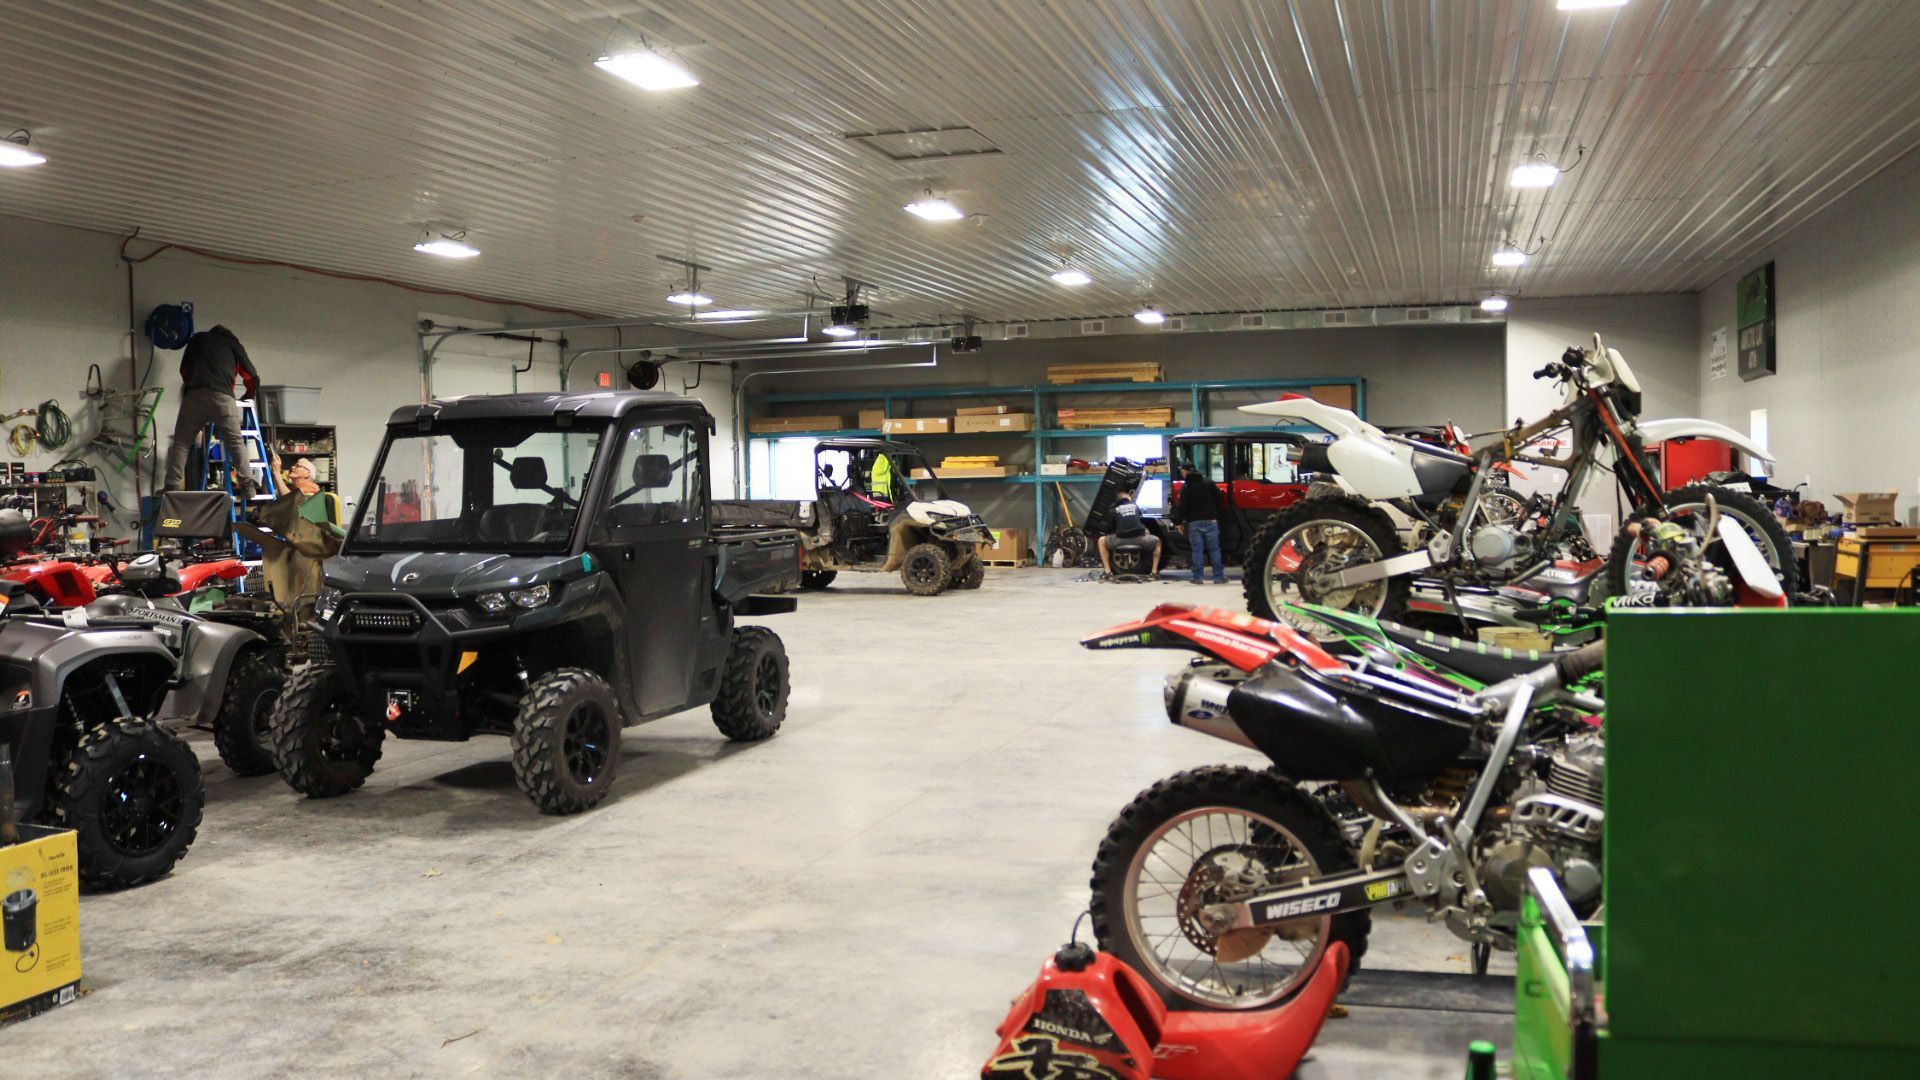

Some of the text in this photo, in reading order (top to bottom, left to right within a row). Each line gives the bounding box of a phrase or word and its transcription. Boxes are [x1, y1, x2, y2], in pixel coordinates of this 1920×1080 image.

[128, 606, 177, 623] SPORTSMAN
[1266, 892, 1342, 920] WISECO
[1032, 1018, 1092, 1042] HONDA
